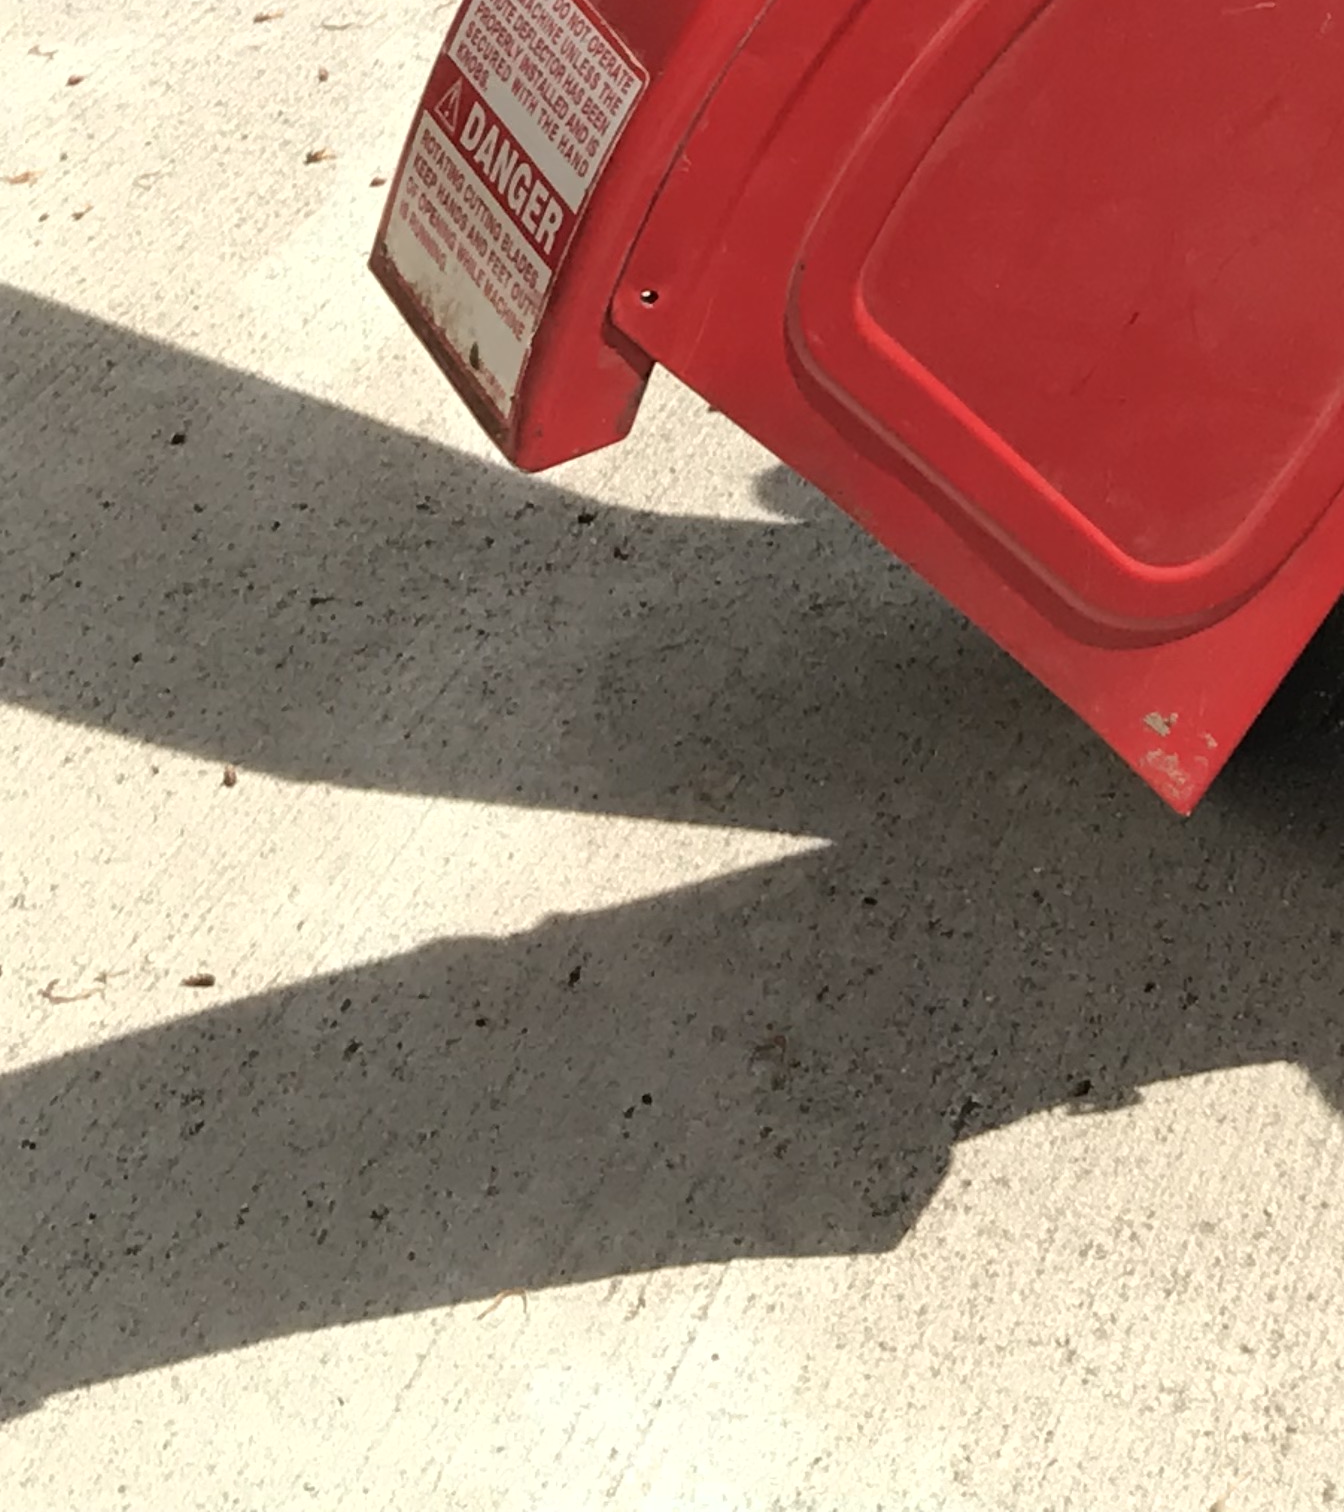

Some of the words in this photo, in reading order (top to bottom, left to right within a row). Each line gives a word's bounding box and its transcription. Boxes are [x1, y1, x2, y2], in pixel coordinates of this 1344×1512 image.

[464, 19, 512, 84] SECURED
[509, 75, 538, 117] WITH
[535, 107, 559, 143] THE
[556, 133, 590, 181] HAND
[474, 0, 522, 64] PROPERLY
[518, 52, 569, 122] INSTALLED
[564, 110, 589, 147] AND
[584, 134, 600, 159] IS
[512, 13, 566, 84] DEFLECTOR
[561, 73, 585, 108] HAS
[580, 95, 610, 138] BEEN
[559, 35, 601, 92] UNLESS
[597, 80, 622, 118] THE
[566, 10, 590, 44] NOT
[585, 33, 634, 96] OPERATE
[412, 150, 438, 193] KEEP
[435, 181, 468, 234] HANDS
[465, 220, 488, 260] AND
[486, 247, 512, 292] FEET
[420, 126, 465, 195] ROTATING
[462, 181, 502, 243] CUTTING
[458, 99, 567, 255] DANGER
[482, 277, 525, 343] MACHINE
